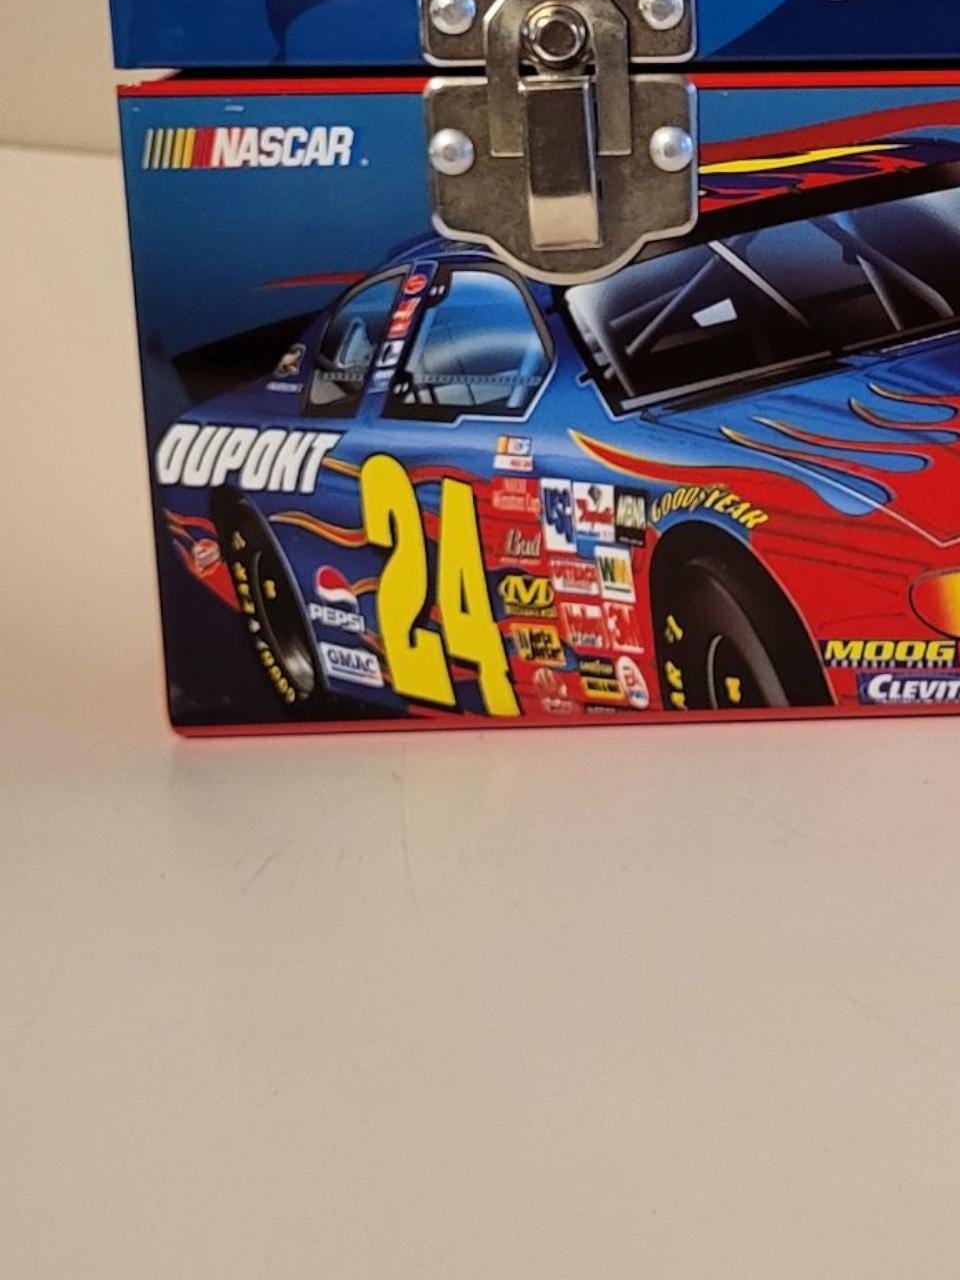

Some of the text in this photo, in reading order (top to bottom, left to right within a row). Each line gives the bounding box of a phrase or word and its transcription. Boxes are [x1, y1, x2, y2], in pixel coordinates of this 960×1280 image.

[211, 125, 355, 168] NASCAR
[156, 423, 342, 495] DUPONT
[505, 527, 542, 557] Bud
[360, 453, 521, 717] 24
[308, 602, 367, 632] PEPSI
[824, 639, 956, 662] MOOG
